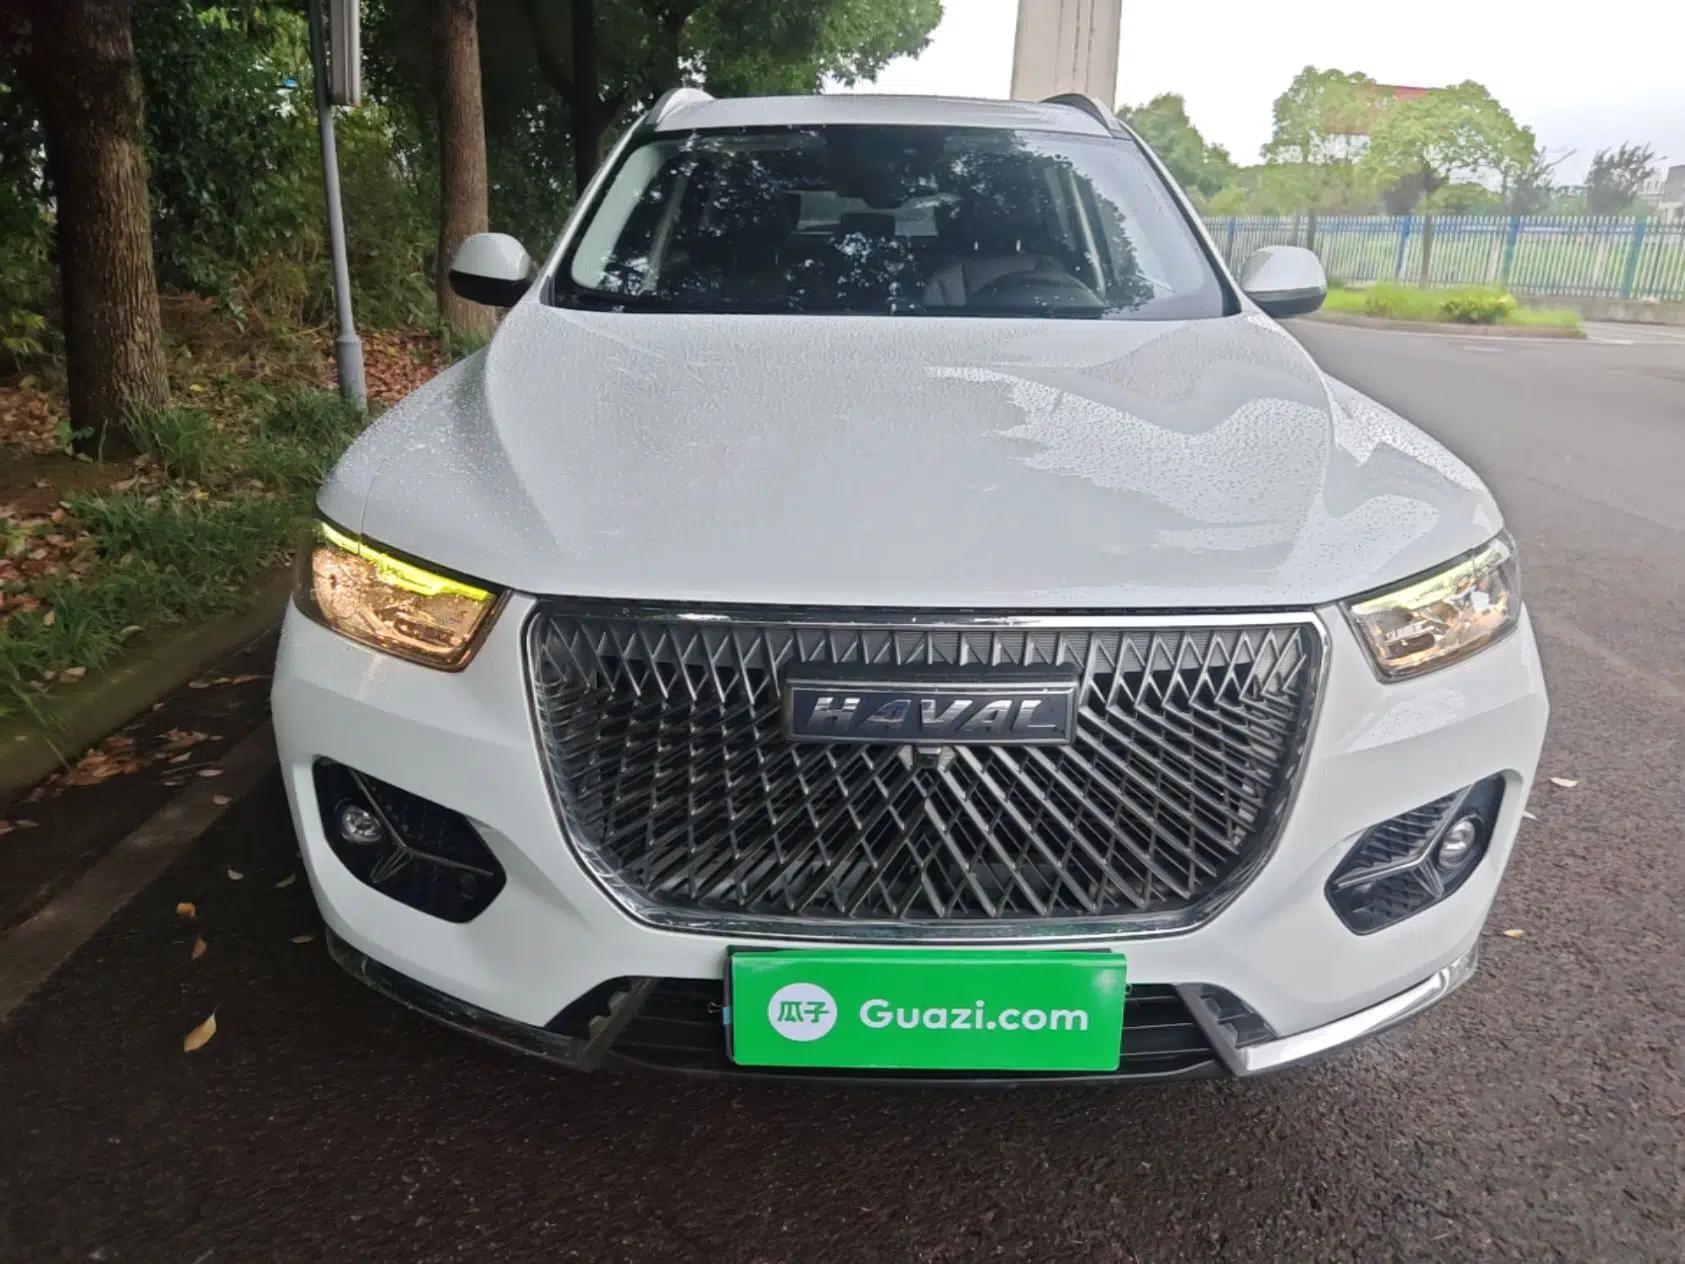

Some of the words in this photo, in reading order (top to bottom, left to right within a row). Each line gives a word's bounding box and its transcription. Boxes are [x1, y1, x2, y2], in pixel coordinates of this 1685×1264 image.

[805, 695, 1058, 733] HAVAL
[778, 1000, 829, 1024] 瓜子
[859, 998, 1089, 1031] Guazi.com
